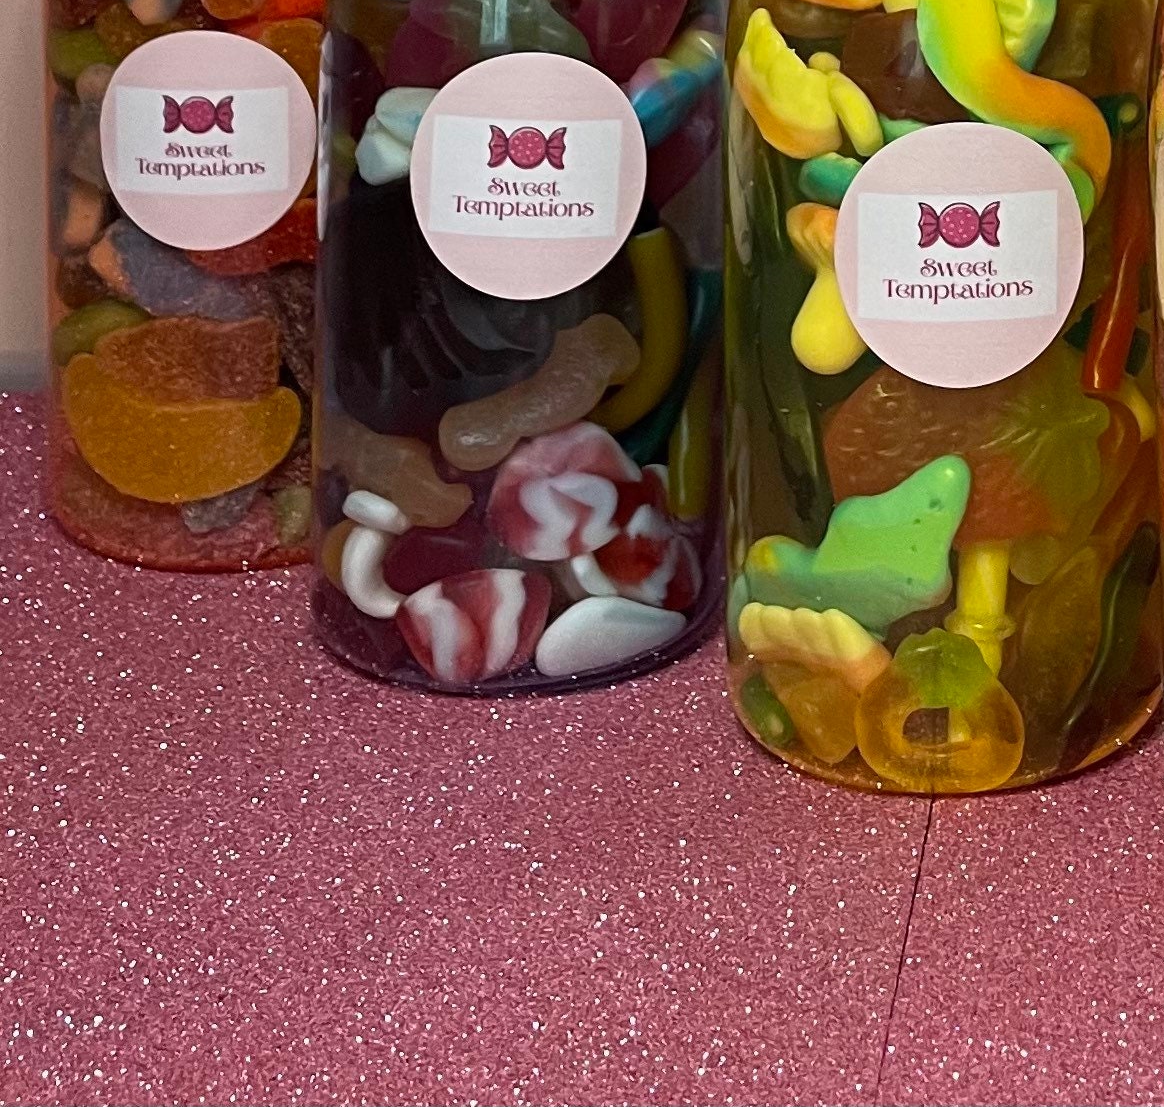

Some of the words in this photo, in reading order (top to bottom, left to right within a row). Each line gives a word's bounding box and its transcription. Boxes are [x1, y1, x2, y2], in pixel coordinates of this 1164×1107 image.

[165, 142, 232, 159] Sweet
[135, 157, 266, 181] Temptations
[487, 177, 561, 196] Sweet
[453, 194, 595, 221] Temptations
[920, 258, 997, 277] Sweet
[882, 278, 1033, 305] Temptations
